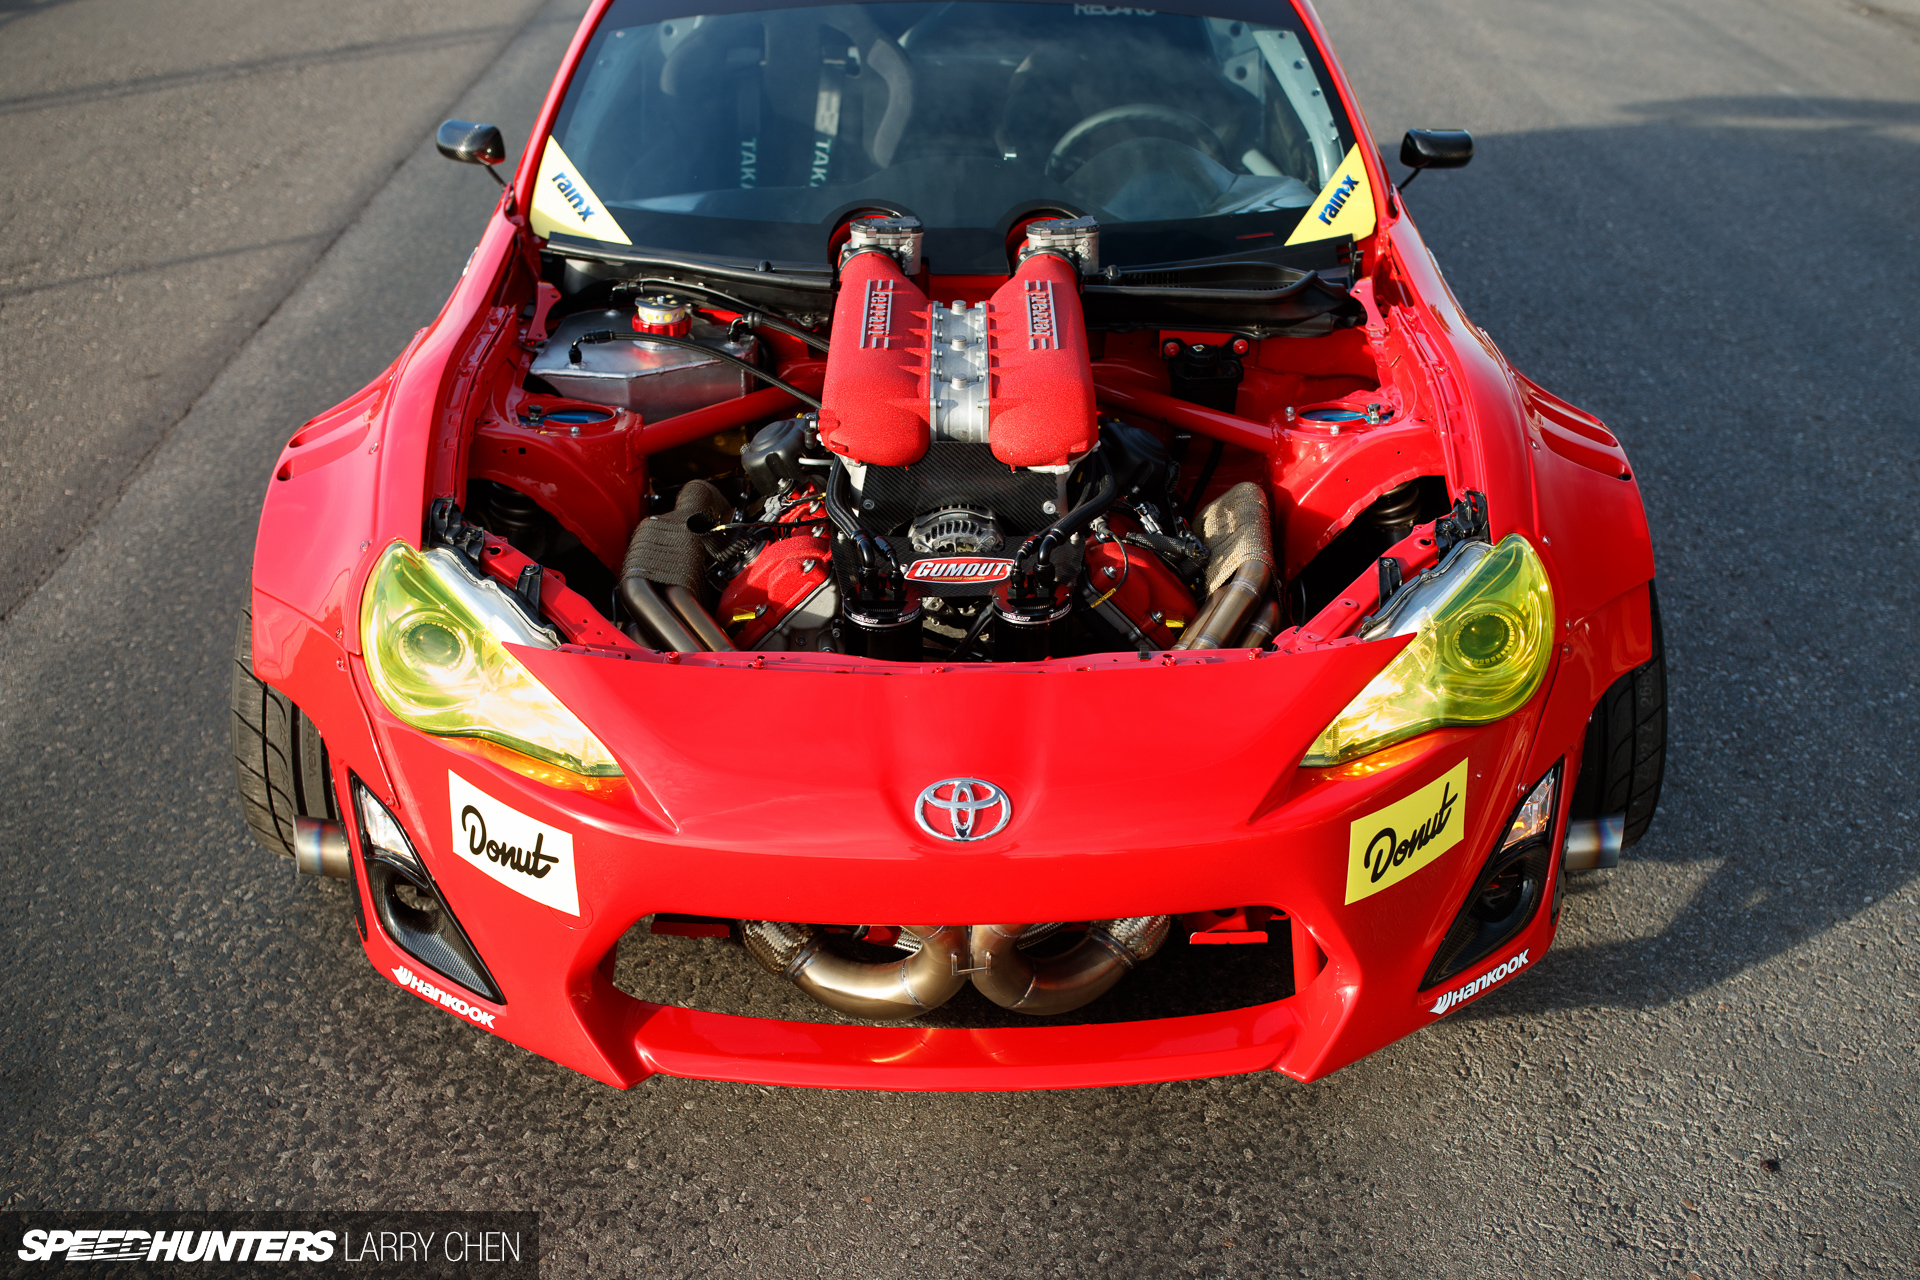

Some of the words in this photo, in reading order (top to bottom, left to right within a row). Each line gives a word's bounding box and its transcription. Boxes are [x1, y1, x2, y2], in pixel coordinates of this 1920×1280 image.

[914, 562, 1009, 577] GUMOUT
[461, 805, 559, 879] Donut
[1364, 782, 1458, 883] Donut
